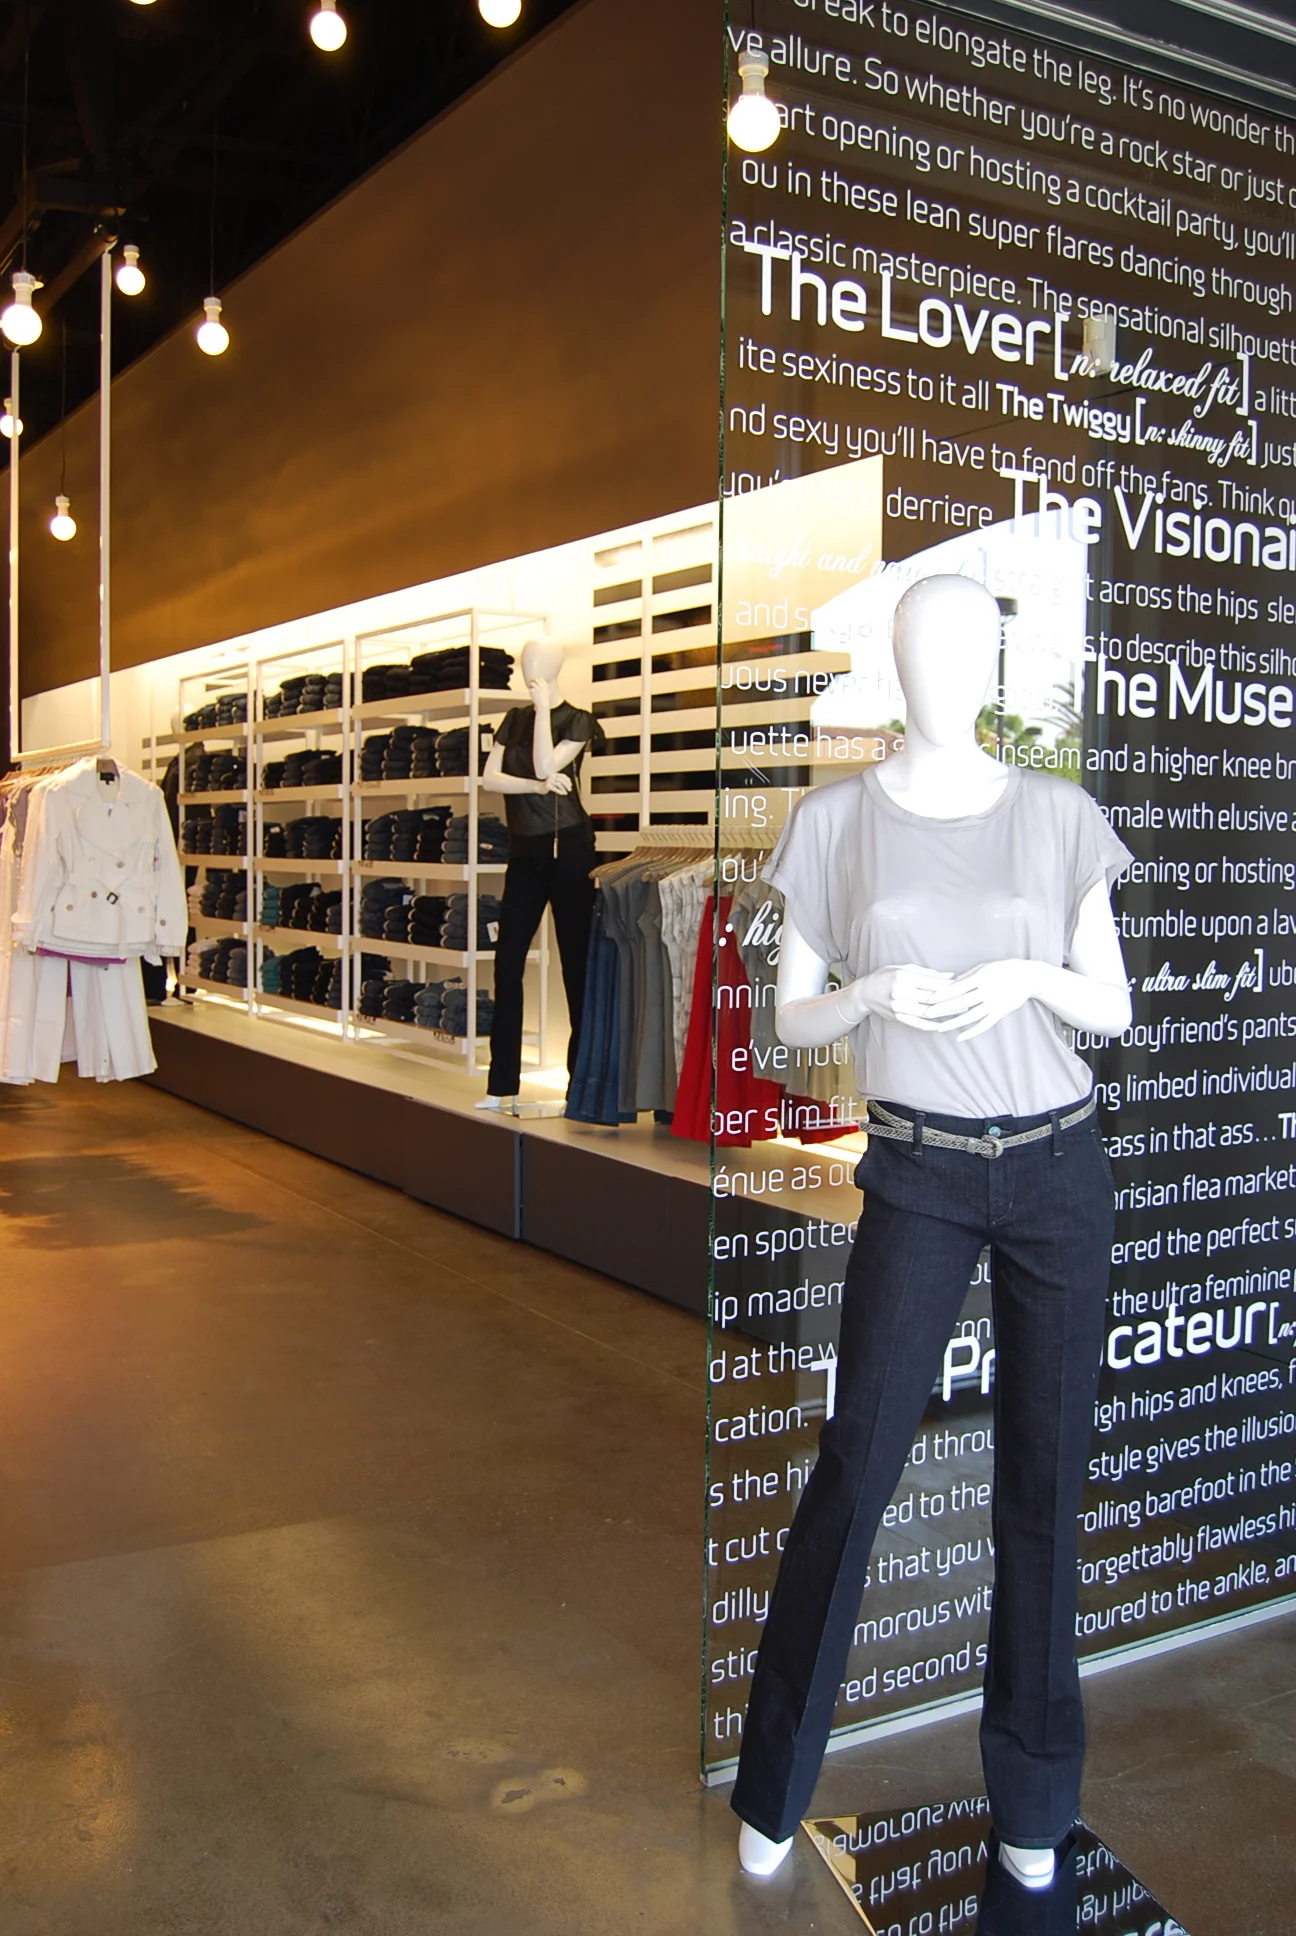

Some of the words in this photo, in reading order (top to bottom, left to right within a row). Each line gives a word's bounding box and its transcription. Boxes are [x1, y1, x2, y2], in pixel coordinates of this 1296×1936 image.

[727, 26, 763, 58] ve
[771, 35, 857, 84] allure.
[865, 58, 898, 94] So
[905, 75, 1016, 126] whether
[1021, 109, 1095, 150] you're
[1120, 138, 1168, 171] rock
[1173, 151, 1216, 183] star
[1221, 168, 1243, 191] or
[1244, 169, 1284, 205] just
[882, 5, 908, 37] to
[916, 15, 1027, 72] elongate
[1033, 48, 1072, 86] the
[1079, 60, 1117, 105] leg.
[1123, 75, 1154, 110] It's
[1159, 94, 1185, 120] no
[1190, 103, 1270, 145] wonder
[743, 160, 777, 188] ou
[788, 162, 811, 197] in
[821, 171, 898, 216] these
[907, 190, 960, 232] lean
[969, 213, 1040, 250] super
[1047, 225, 1114, 268] flares
[1120, 245, 1205, 298] dancing
[1211, 268, 1292, 316] through
[822, 116, 930, 172] opening
[937, 145, 964, 172] or
[970, 145, 1061, 205] hosting
[1086, 184, 1171, 228] cocktail
[1176, 209, 1239, 251] party,
[1244, 228, 1295, 260] you'll
[743, 241, 867, 332] The
[1109, 347, 1211, 400] relaxed
[754, 220, 846, 267] classic
[852, 246, 1021, 305] masterpiece.
[1027, 277, 1072, 316] The
[1077, 296, 1204, 344] sensational
[739, 336, 776, 373] ite
[783, 352, 901, 395] sexiness
[907, 368, 934, 401] to
[940, 374, 956, 406] it
[962, 380, 989, 411] all
[996, 383, 1043, 420] The
[1167, 419, 1224, 465] skinny
[730, 403, 766, 436] nd
[773, 413, 839, 455] sexy
[846, 423, 915, 459] you'll
[922, 429, 985, 470] have
[991, 443, 1016, 473] to
[1021, 447, 1076, 484] fend
[1082, 460, 1115, 490] off
[1120, 464, 1156, 495] the
[1161, 470, 1213, 507] fans.
[1217, 480, 1275, 517] Think
[886, 487, 992, 528] derriere
[1000, 467, 1101, 544] The
[736, 598, 788, 629] and
[1099, 631, 1121, 660] to
[1126, 633, 1216, 668] describe
[1220, 644, 1256, 673] this
[1100, 579, 1172, 609] across
[1177, 584, 1211, 614] the
[1217, 588, 1257, 624] hips
[1169, 659, 1294, 728] Muse
[725, 788, 773, 827] ing.
[1167, 802, 1213, 829] with
[1220, 803, 1287, 831] elusive
[731, 726, 808, 757] uette
[817, 727, 864, 760] has
[996, 737, 1080, 770] inseam
[1086, 743, 1128, 772] and
[1151, 744, 1219, 781] higher
[1223, 749, 1271, 779] knee
[1195, 861, 1217, 883] or
[1223, 856, 1295, 890] hosting
[1202, 914, 1251, 942] upon
[1142, 961, 1190, 993] ultra
[1192, 960, 1230, 991] slim
[731, 1039, 788, 1072] e've
[1243, 1012, 1296, 1046] pants
[765, 1098, 820, 1133] slim
[828, 1095, 857, 1126] fit
[1127, 1069, 1197, 1101] limbed
[1203, 1062, 1296, 1096] individual
[714, 1234, 748, 1259] en
[1183, 1174, 1220, 1201] flea
[1225, 1163, 1296, 1197] market
[791, 1165, 822, 1190] as
[1150, 1127, 1168, 1154] in
[1173, 1122, 1215, 1152] that
[714, 1291, 738, 1329] ip
[1111, 1231, 1160, 1265] ered
[1167, 1228, 1201, 1256] the
[1207, 1216, 1279, 1257] perfect
[733, 1347, 761, 1379] at
[768, 1341, 814, 1374] the
[1113, 1288, 1148, 1317] the
[1152, 1281, 1201, 1309] ultra
[1206, 1266, 1290, 1302] feminine
[715, 1404, 808, 1442] cation.
[732, 1469, 778, 1502] the
[1131, 1389, 1174, 1422] hips
[1179, 1375, 1216, 1408] and
[1221, 1368, 1283, 1400] knees,
[712, 1586, 769, 1624] dilly
[878, 1548, 930, 1584] that
[936, 1539, 981, 1577] you
[1146, 1472, 1235, 1517] barefoot
[1239, 1468, 1256, 1494] in
[1260, 1460, 1291, 1487] the
[725, 1527, 769, 1561] cut
[919, 1492, 944, 1518] to
[951, 1481, 990, 1512] the
[1088, 1445, 1142, 1481] style
[1146, 1435, 1200, 1472] gives
[1204, 1424, 1237, 1452] the
[854, 1601, 950, 1646] morous
[1197, 1513, 1276, 1554] flawless
[882, 1641, 970, 1693] second
[1075, 1592, 1147, 1637] toured
[1152, 1590, 1172, 1615] to
[1177, 1579, 1209, 1606] the
[1214, 1561, 1269, 1596] ankle,
